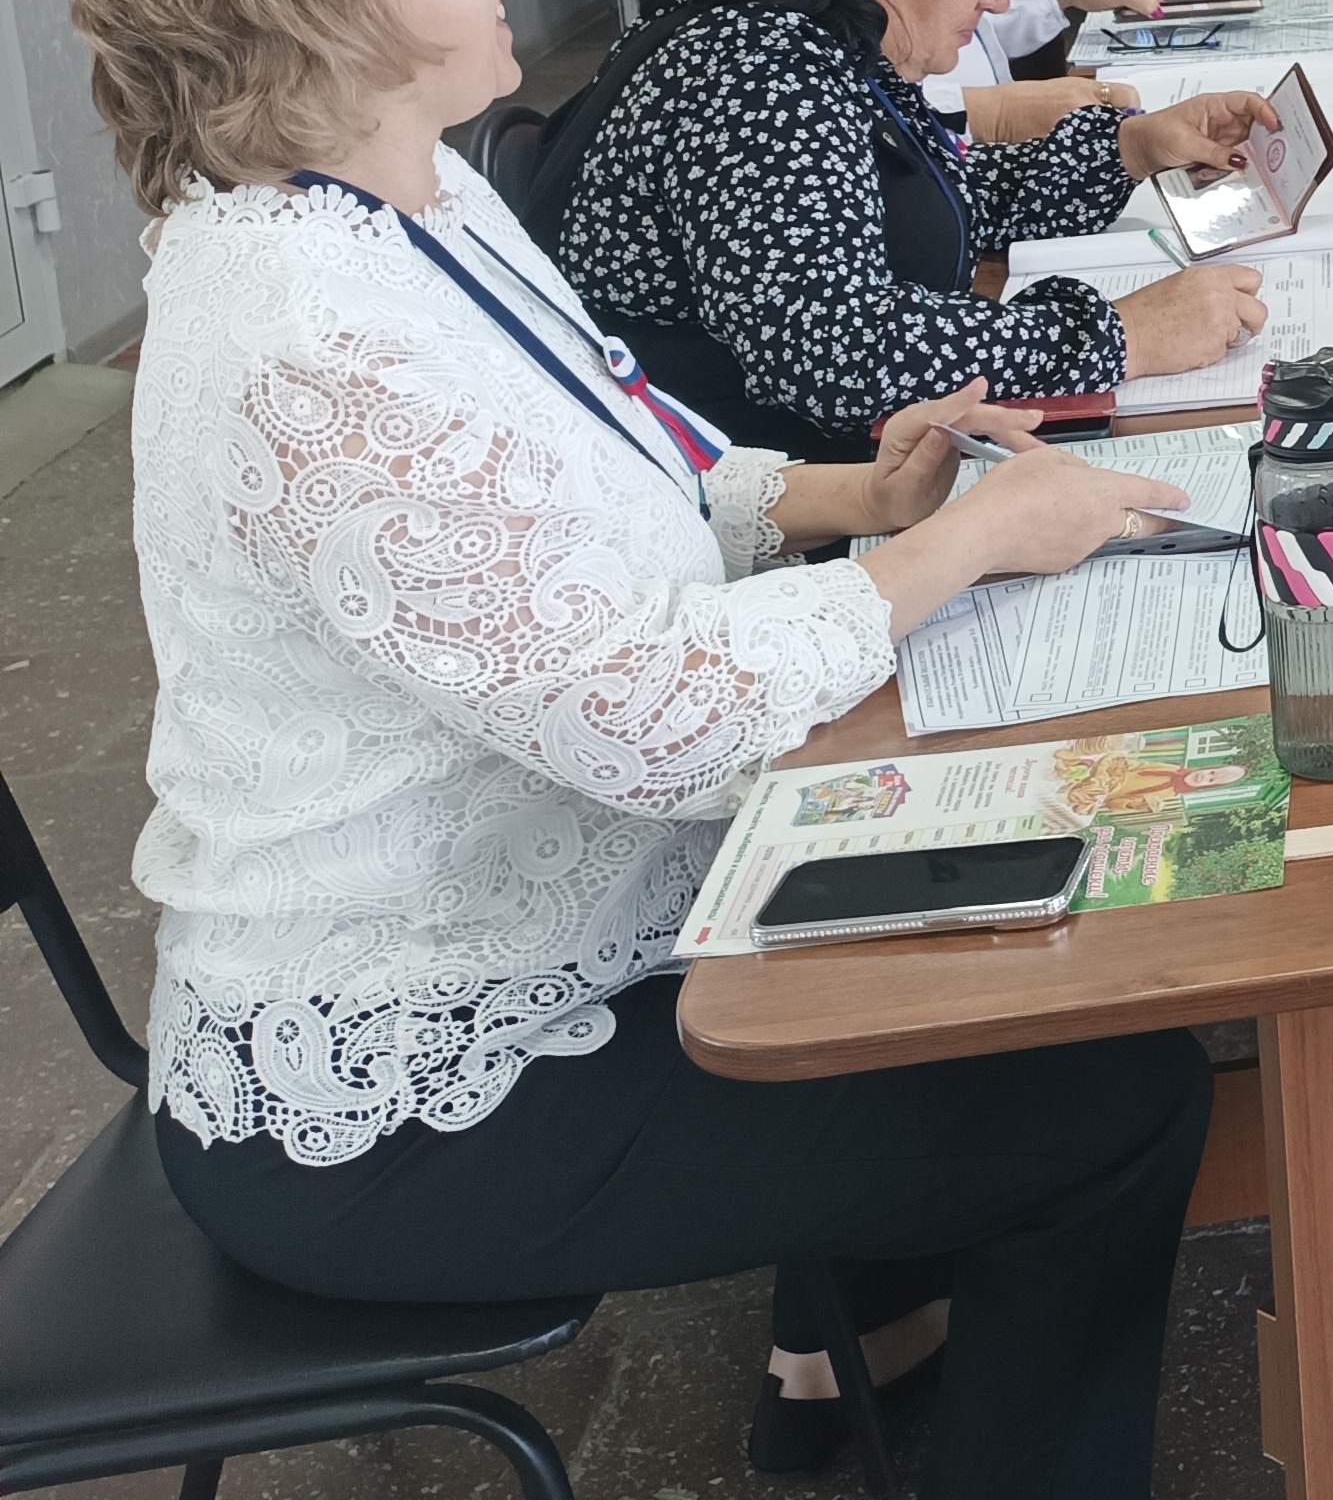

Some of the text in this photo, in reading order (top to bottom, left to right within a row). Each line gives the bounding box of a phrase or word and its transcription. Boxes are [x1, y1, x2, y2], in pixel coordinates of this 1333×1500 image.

[1084, 842, 1111, 900] подписки!
[1109, 836, 1138, 874] газеты
[1141, 823, 1173, 887] Прекрасные
